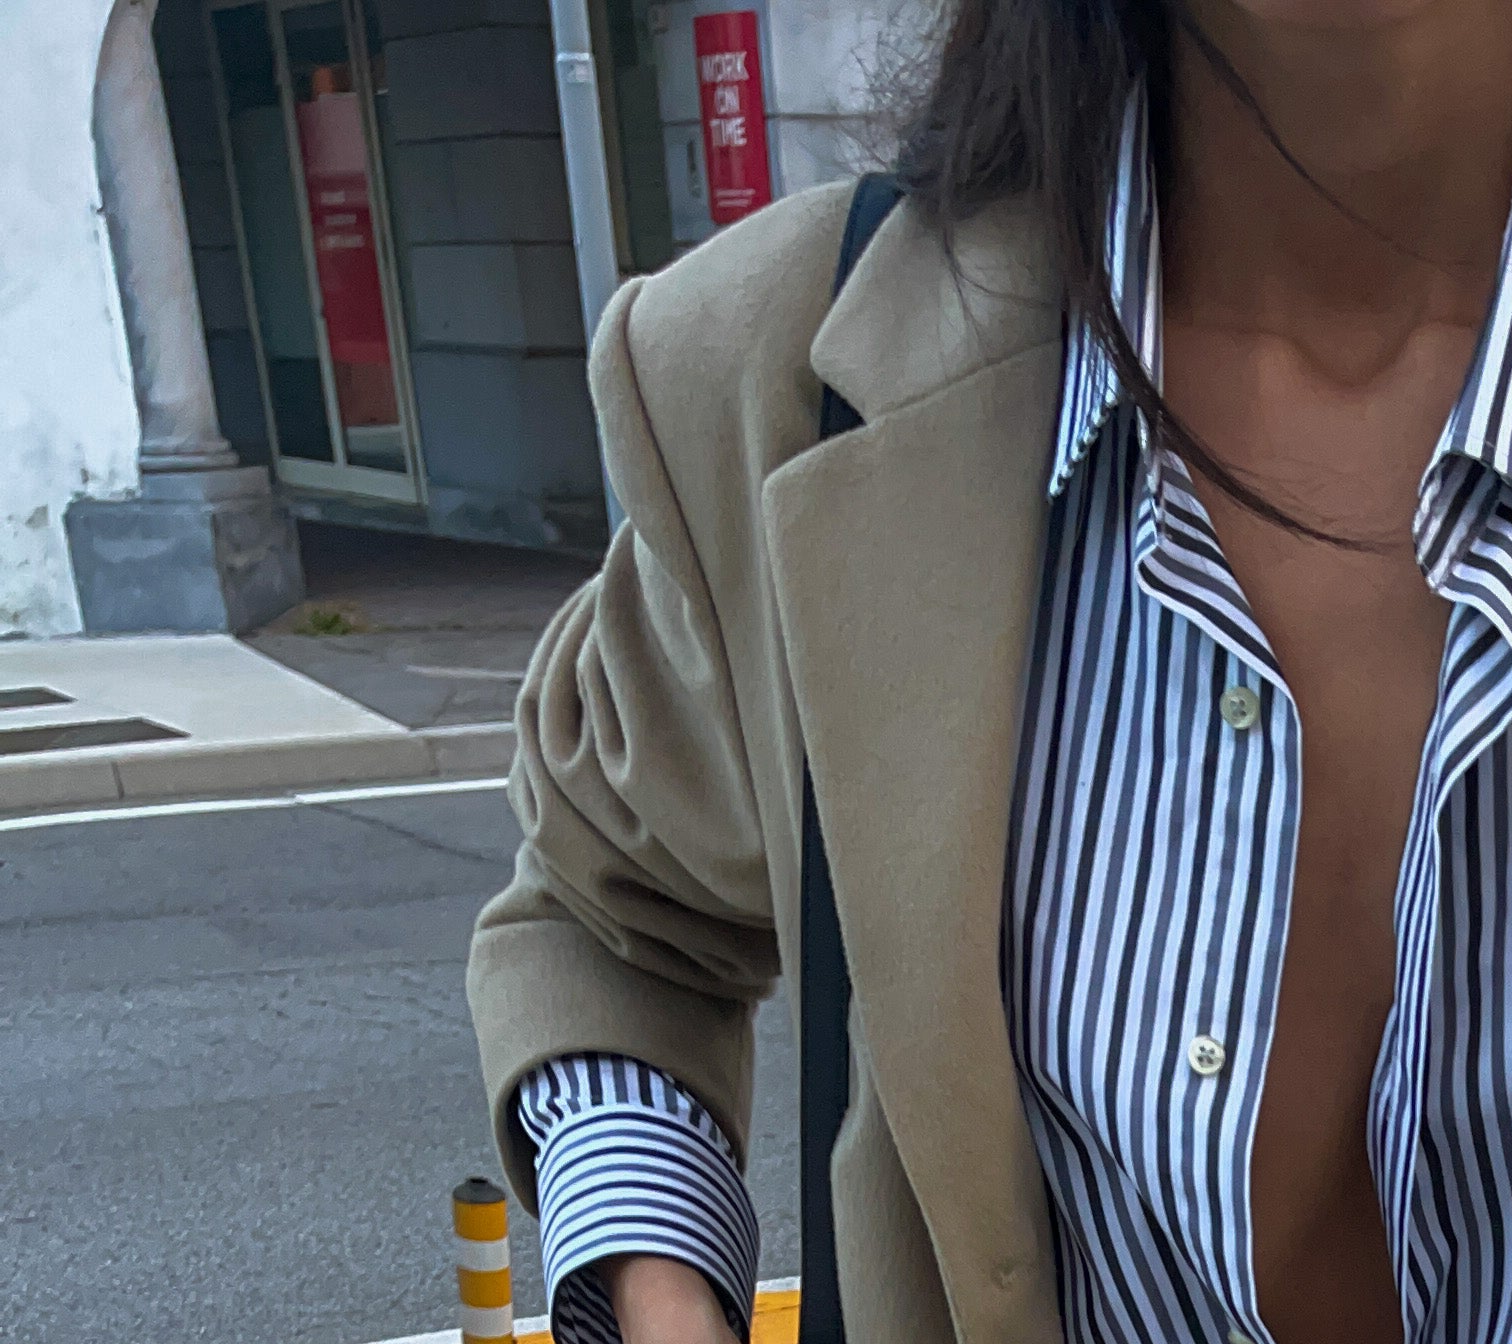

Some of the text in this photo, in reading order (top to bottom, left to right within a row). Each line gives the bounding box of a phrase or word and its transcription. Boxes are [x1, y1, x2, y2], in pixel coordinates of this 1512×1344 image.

[702, 52, 749, 82] WORK
[714, 85, 740, 115] ON
[710, 117, 747, 147] TIME
